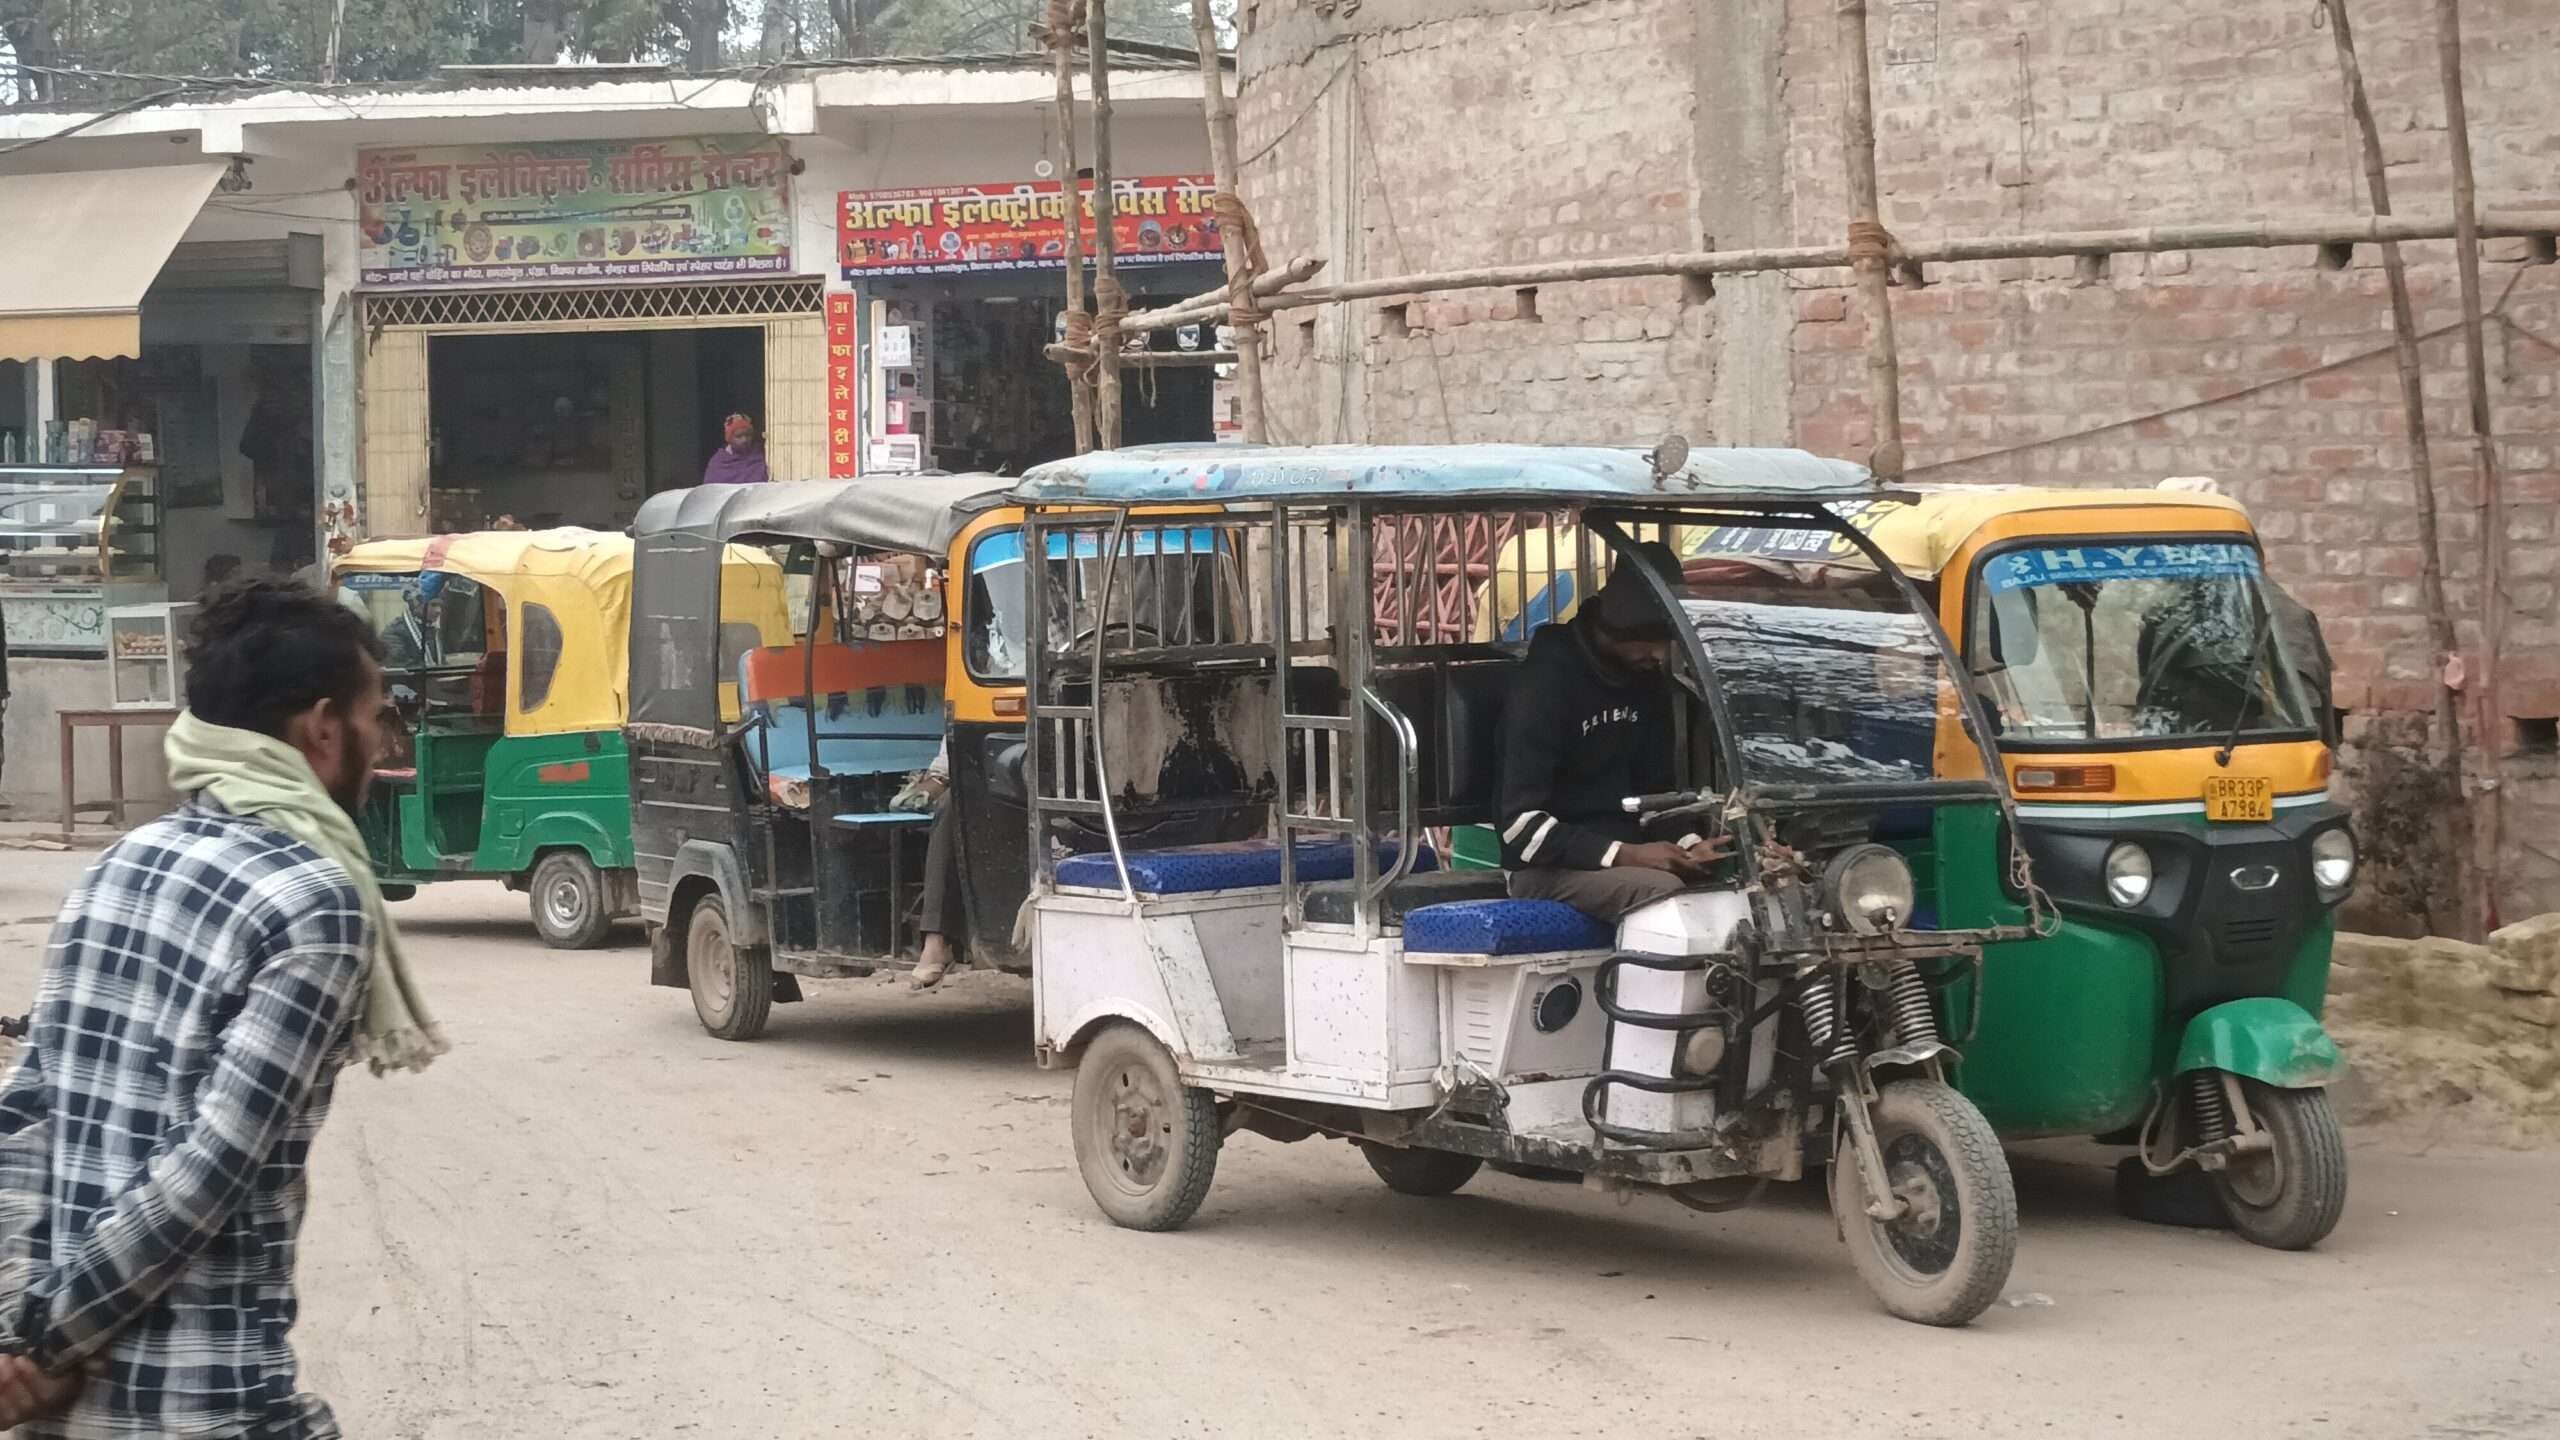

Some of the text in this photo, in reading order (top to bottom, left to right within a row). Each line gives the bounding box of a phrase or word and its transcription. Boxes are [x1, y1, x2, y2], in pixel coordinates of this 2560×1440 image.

[605, 144, 695, 193] सर्विस
[845, 199, 933, 229] अल्फा
[2217, 779, 2264, 798] BR33P
